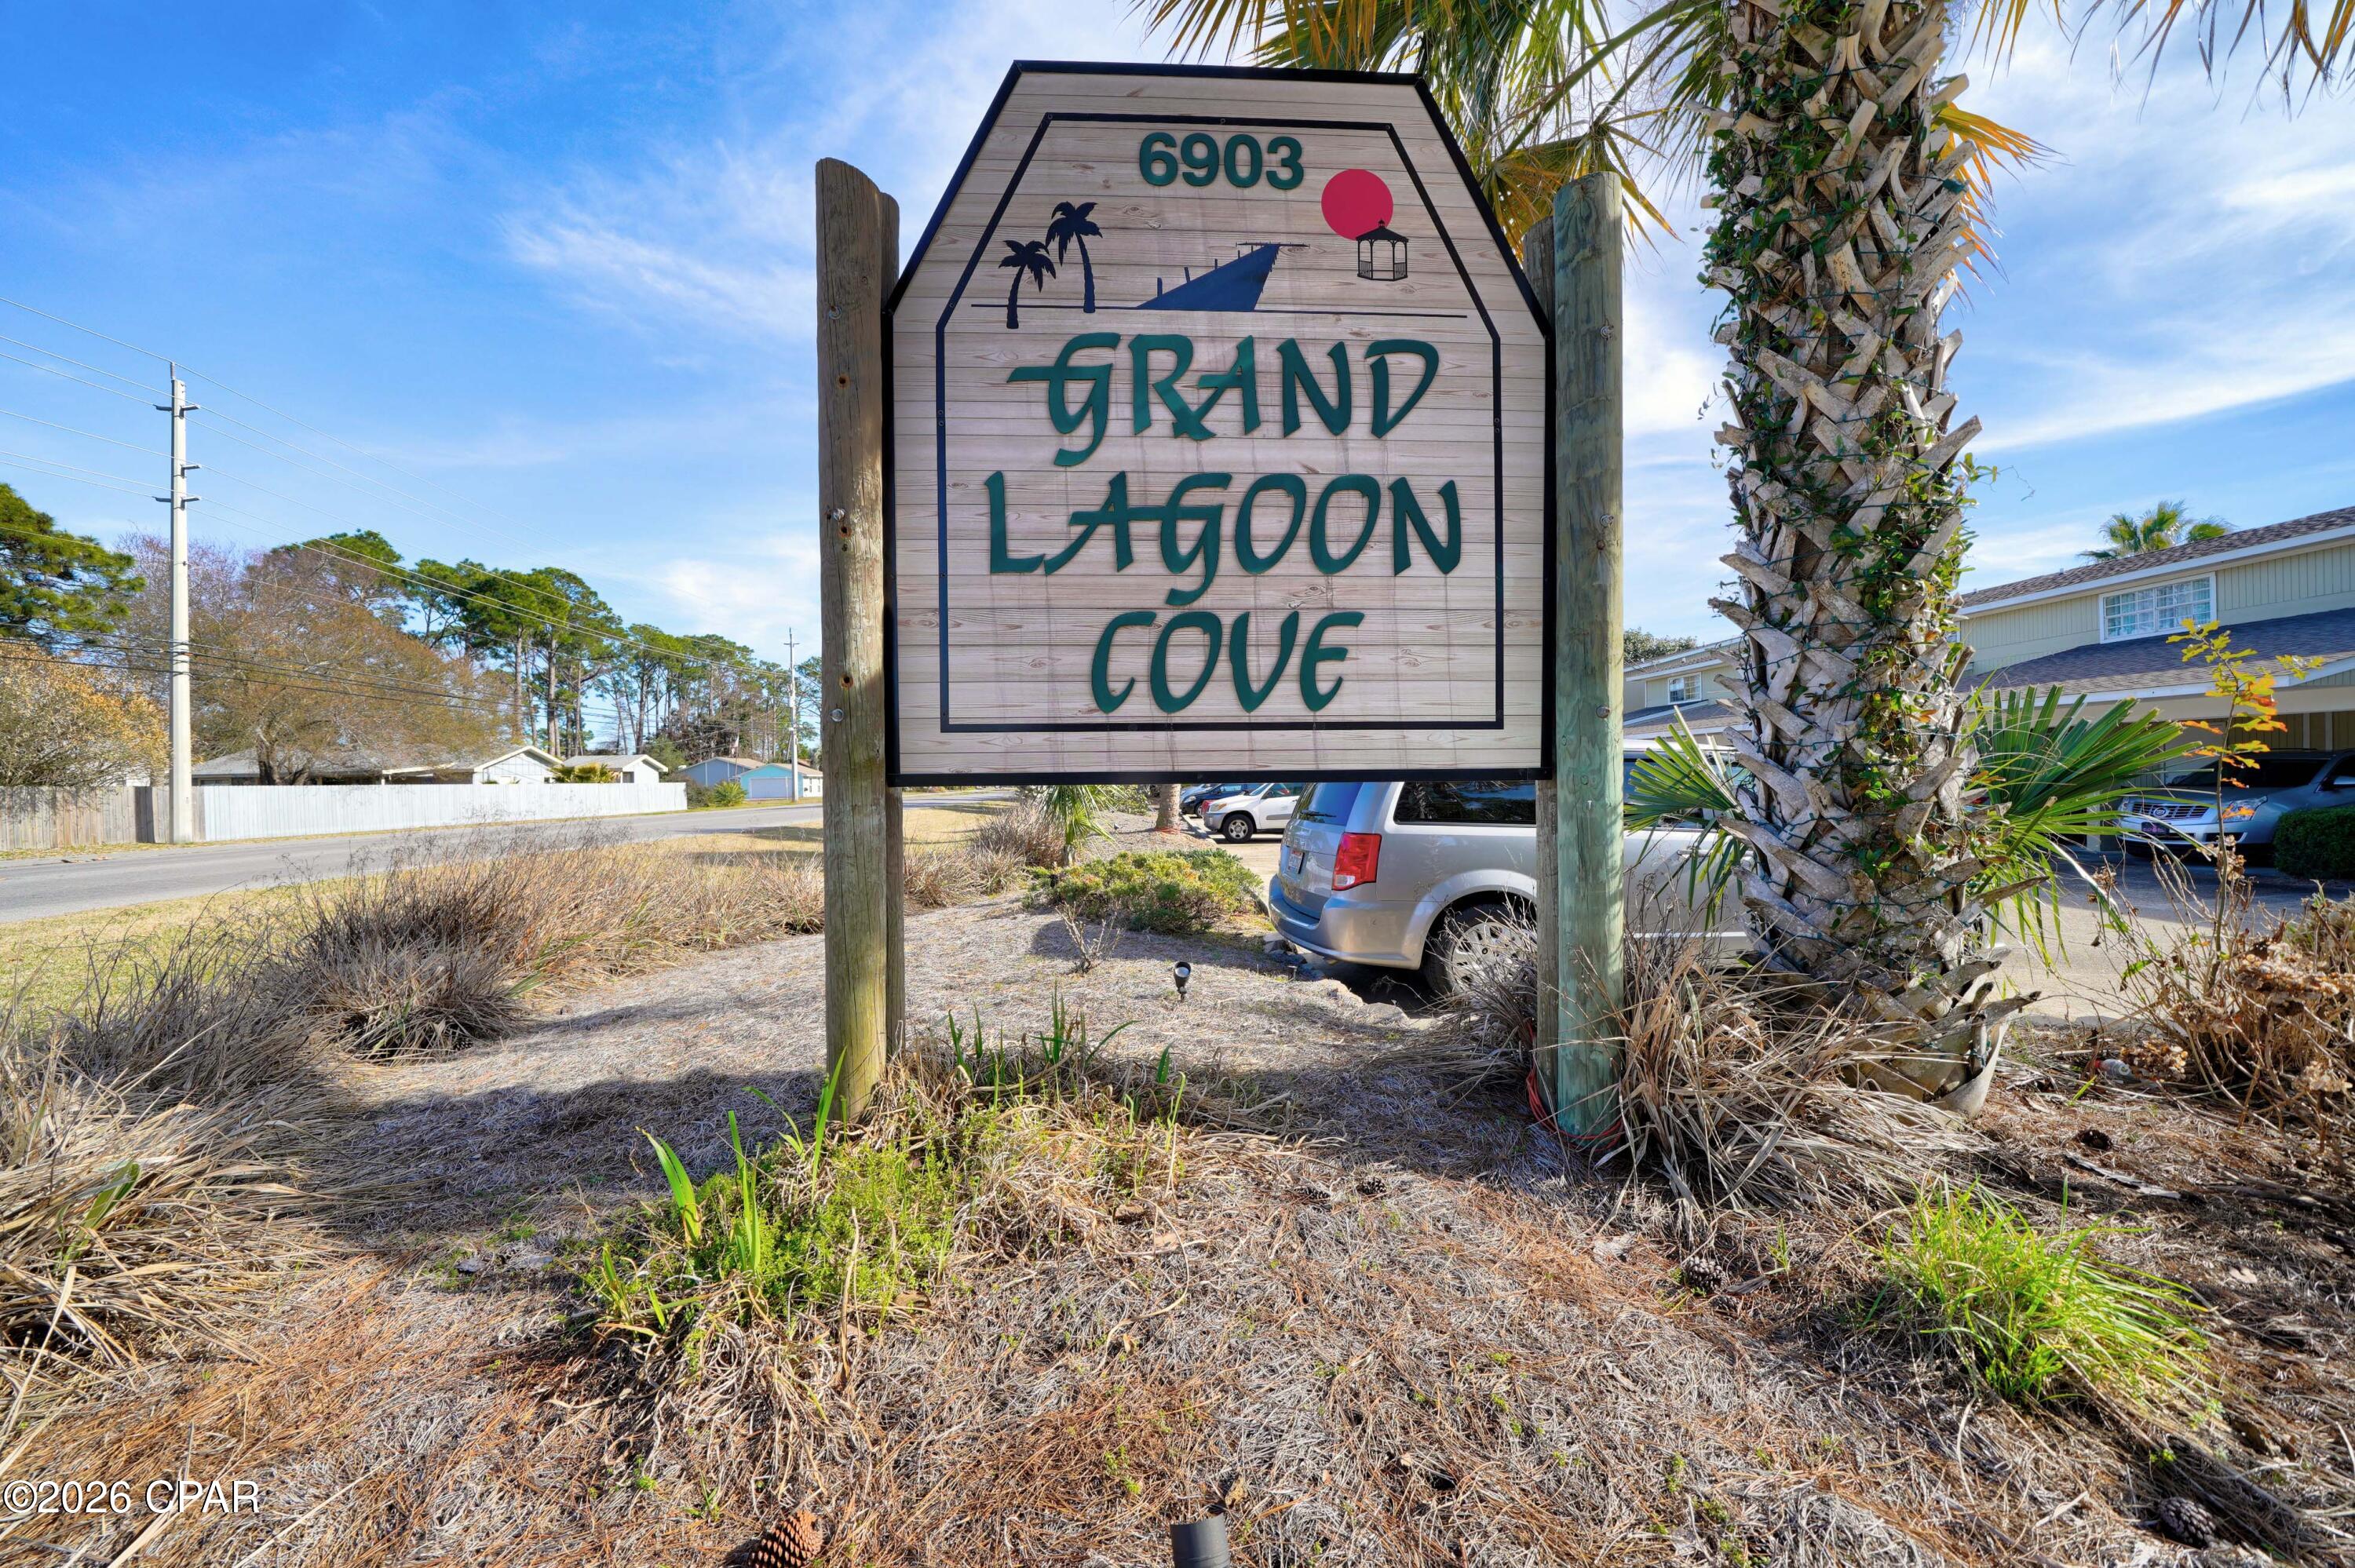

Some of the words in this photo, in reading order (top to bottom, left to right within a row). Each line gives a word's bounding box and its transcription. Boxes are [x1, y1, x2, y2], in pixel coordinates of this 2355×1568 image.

[1138, 132, 1305, 190] 6903
[1006, 331, 1440, 467] GRAND
[984, 471, 1462, 607] LAGOON
[1090, 611, 1366, 714] COVE
